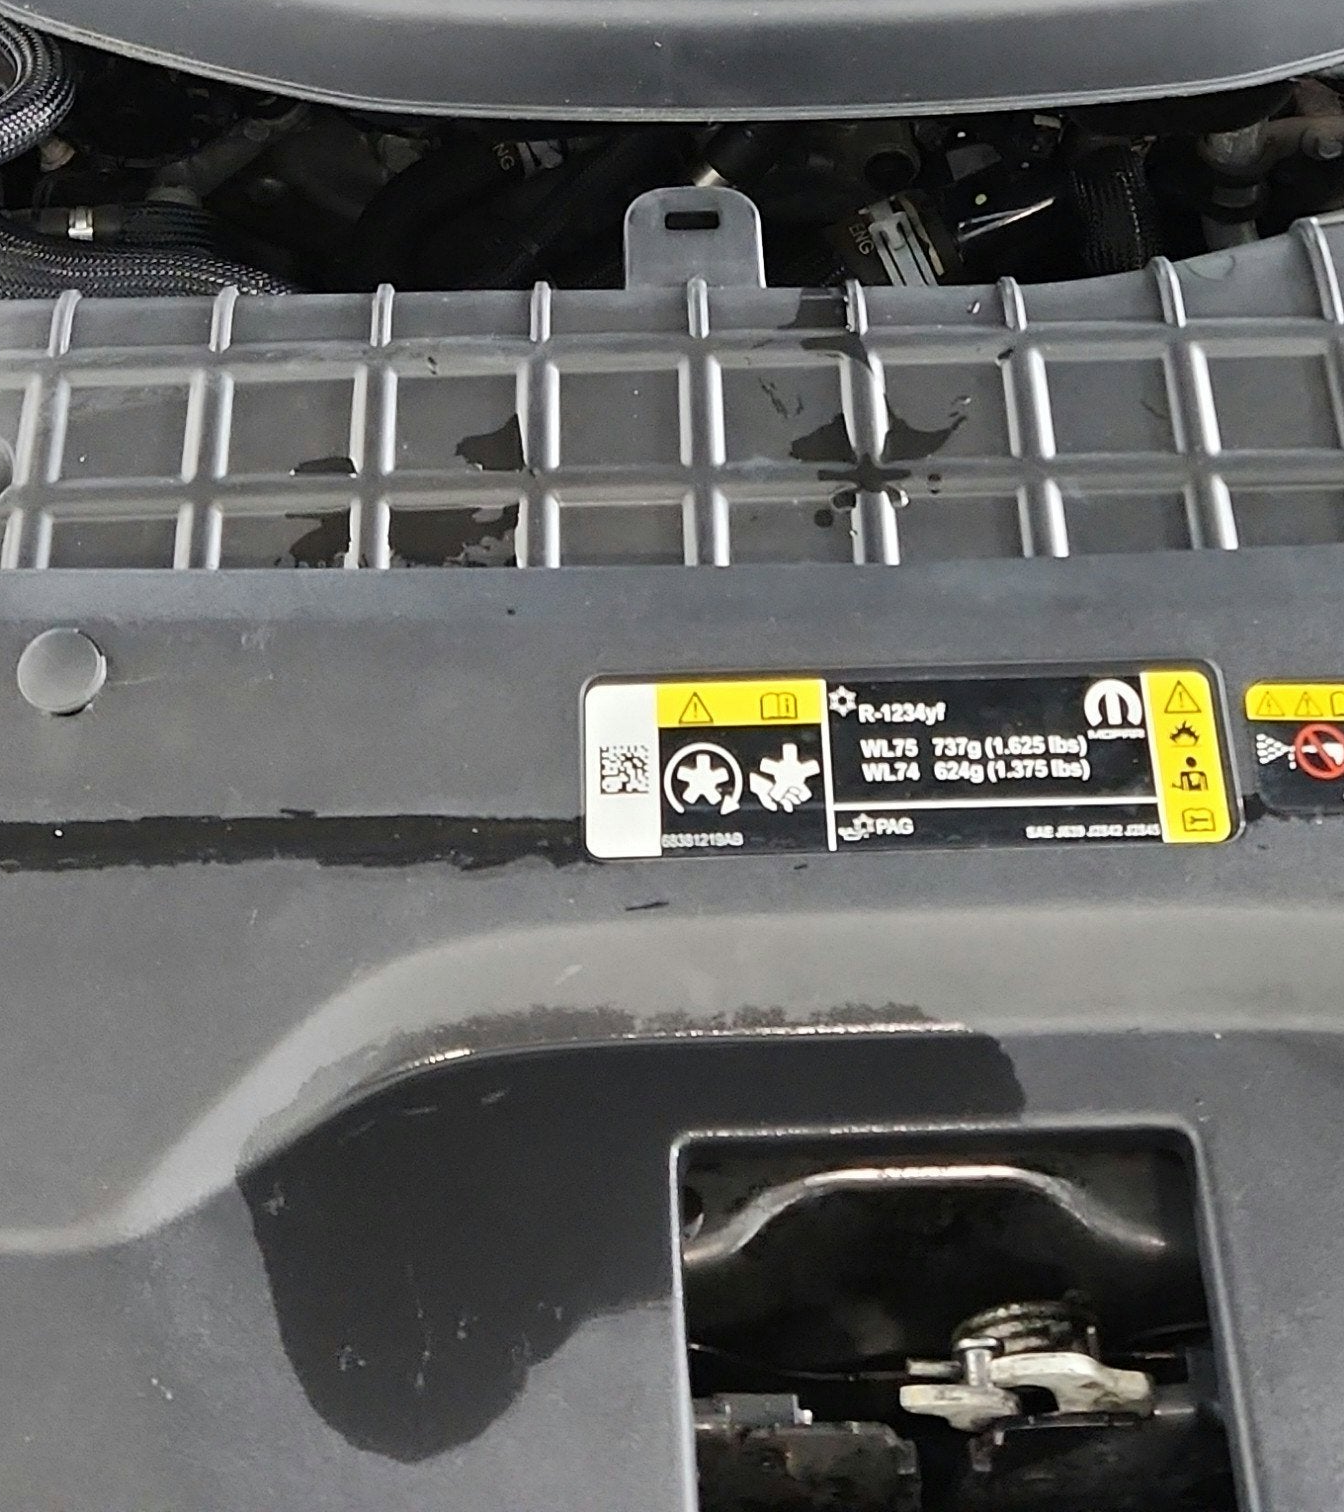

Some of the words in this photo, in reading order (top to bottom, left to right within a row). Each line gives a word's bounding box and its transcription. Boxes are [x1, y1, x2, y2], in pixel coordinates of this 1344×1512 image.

[848, 222, 875, 256] ENG
[858, 701, 947, 726] R-1234yf
[859, 738, 919, 759] WL75
[932, 737, 983, 760] 737g
[984, 735, 1046, 759] (1.625
[1047, 735, 1088, 758] lbs)
[861, 761, 921, 783] WL74
[934, 760, 985, 784] 624g
[986, 759, 1049, 783] (1.375
[1050, 758, 1091, 782] lbs)
[875, 817, 915, 836] PAG
